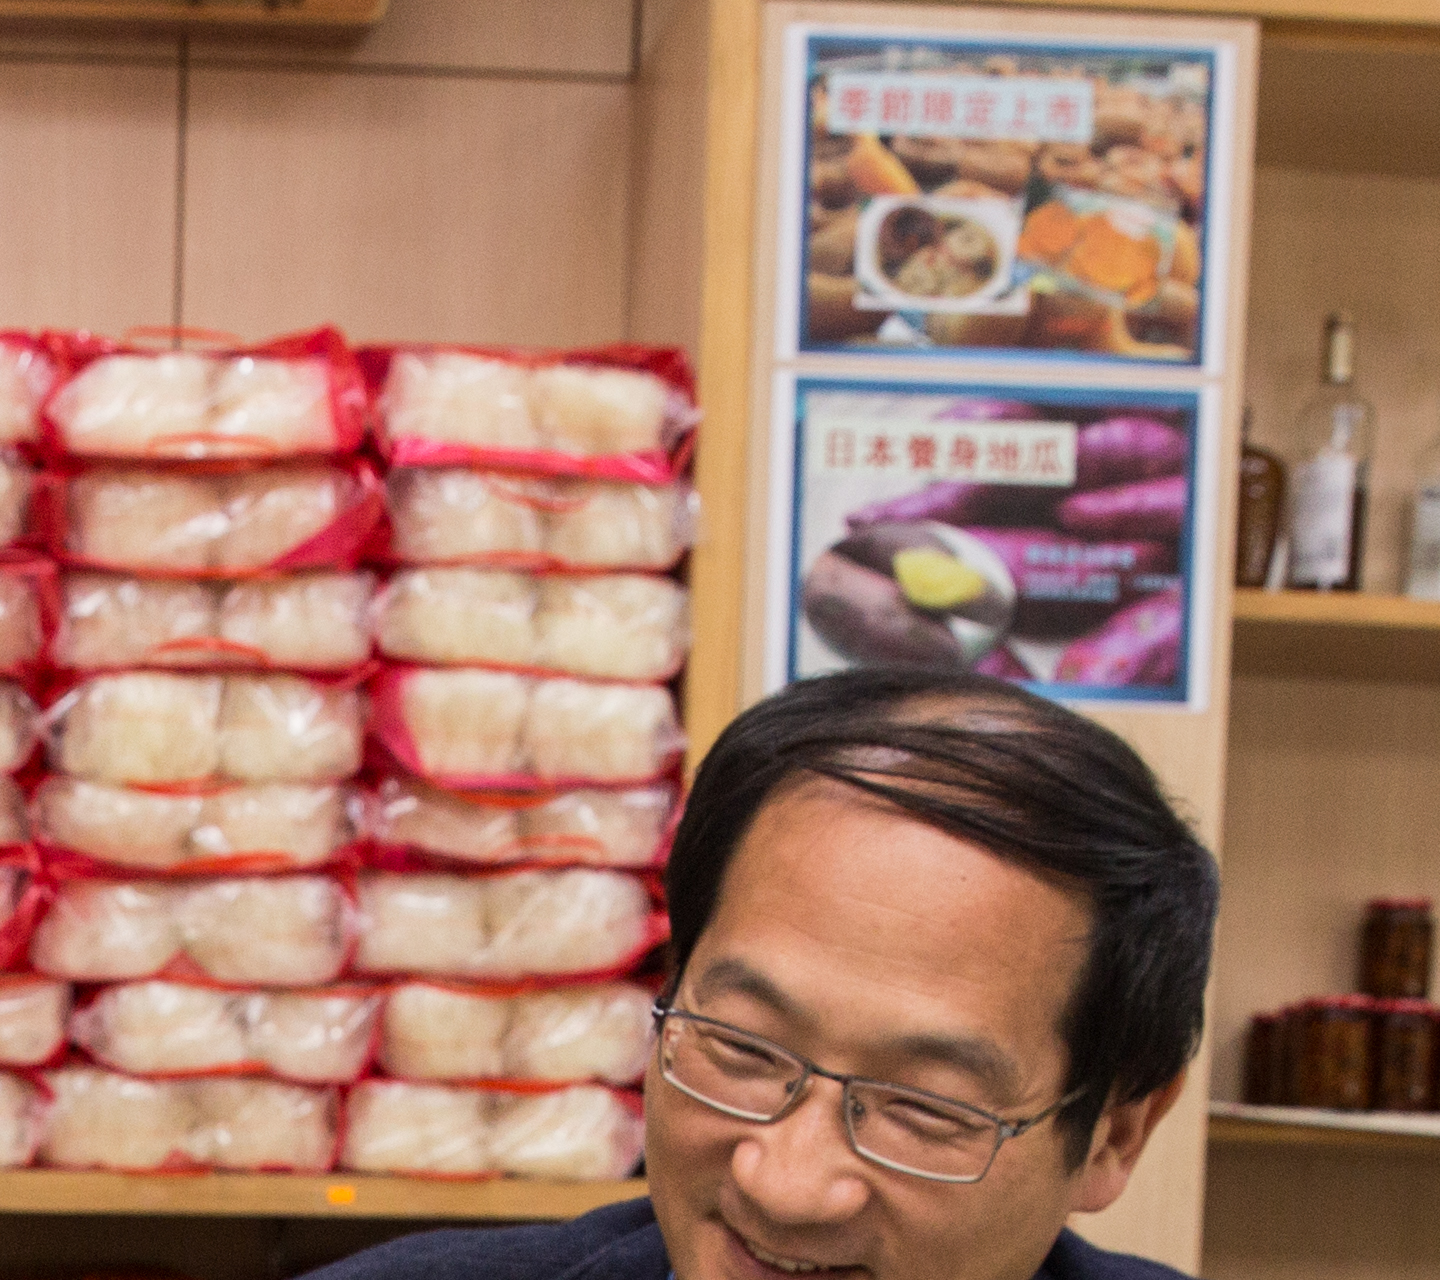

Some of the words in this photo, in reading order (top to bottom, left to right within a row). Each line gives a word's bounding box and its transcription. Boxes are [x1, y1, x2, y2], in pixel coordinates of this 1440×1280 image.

[823, 430, 1065, 475] 日本養身地瓜
